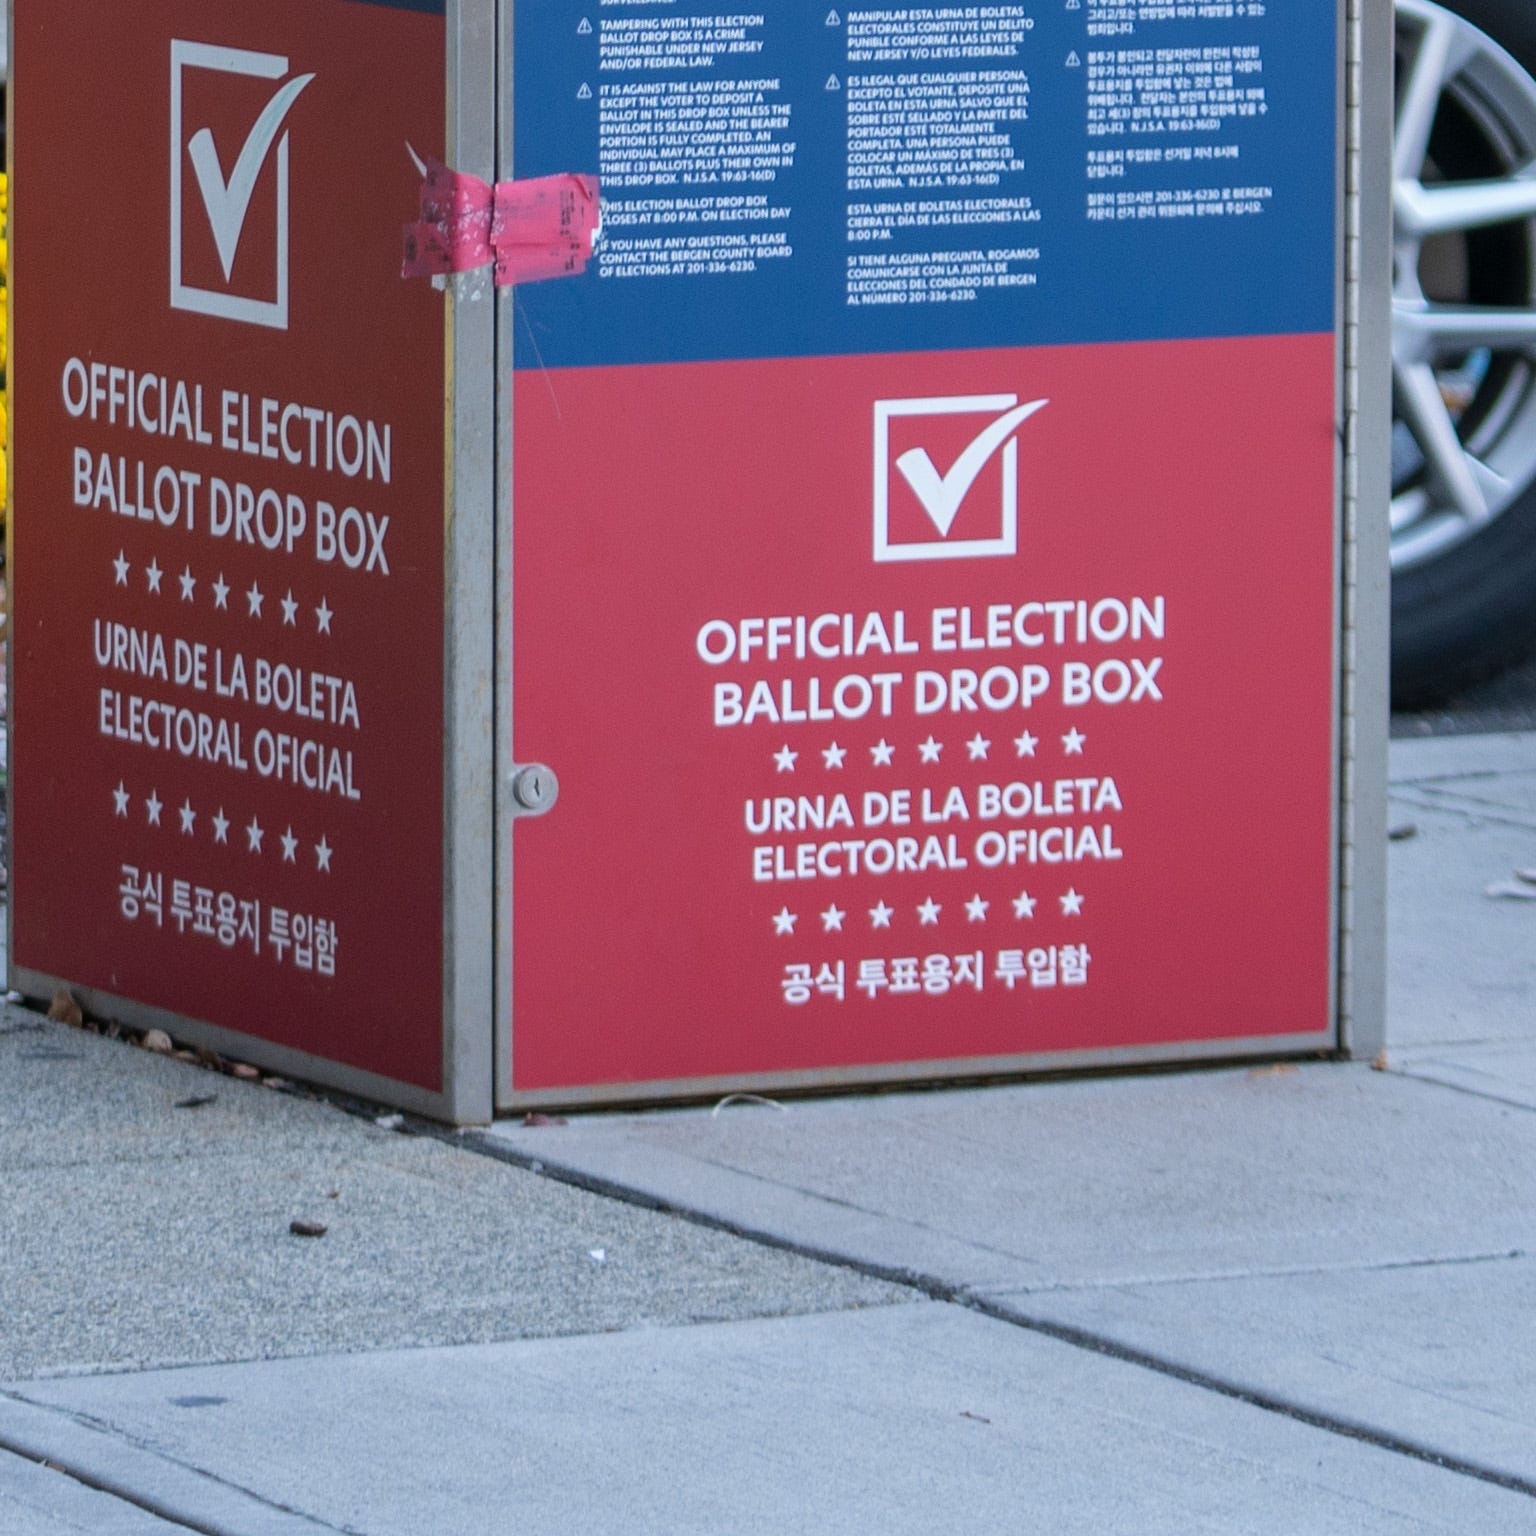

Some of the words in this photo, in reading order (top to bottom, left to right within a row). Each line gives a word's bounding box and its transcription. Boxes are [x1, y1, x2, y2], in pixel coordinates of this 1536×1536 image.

[600, 18, 660, 30] TAMPERING
[660, 17, 689, 28] WITH
[691, 16, 713, 27] THIS
[715, 15, 764, 26] ELECTION
[600, 32, 639, 43] BALLOT
[640, 31, 670, 42] DROP
[670, 30, 692, 41] BOX
[694, 30, 704, 40] IS
[705, 30, 713, 40] A
[714, 28, 745, 39] CRIME
[600, 44, 663, 56] PUNISHABLE
[665, 43, 700, 54] UNDER
[702, 42, 727, 53] NEW
[728, 41, 763, 52] JERSEY
[600, 57, 642, 69] AND/OR
[643, 56, 688, 68] FEDERAL
[599, 240, 609, 250] IF
[611, 239, 633, 250] YOU
[634, 238, 662, 249] HAVE
[664, 237, 686, 248] ANY
[750, 233, 786, 244] PLEASE
[599, 252, 647, 264] CONTACT
[649, 251, 668, 262] THE
[670, 249, 711, 261] BERGEN
[712, 247, 755, 259] COUNTY
[756, 246, 792, 257] BOARD
[599, 266, 614, 277] OF
[615, 264, 671, 276] ELECTIONS
[672, 263, 685, 273] AT
[62, 356, 212, 444] OFFICIAL
[221, 389, 391, 483] ELECTION
[73, 446, 200, 530] BALLOT
[210, 477, 306, 553] DROP
[316, 501, 390, 576] BOX
[696, 610, 918, 665] OFFICIAL
[932, 595, 1164, 650] ELECTION
[94, 618, 167, 681] URNA
[174, 638, 207, 687] DE
[215, 648, 248, 700] LA
[256, 659, 360, 730] BOLETA
[714, 673, 902, 727] BALLOT
[915, 664, 1050, 715] DROP
[1063, 657, 1163, 707] BOX
[99, 688, 247, 769] ELECTORAL
[254, 728, 360, 799] OFICIAL
[745, 793, 854, 834] URNA
[864, 790, 910, 827] DE
[922, 785, 968, 823] LA
[978, 777, 1123, 819] BOLETA
[753, 834, 967, 882] ELECTORAL
[975, 825, 1123, 866] OFICIAL
[119, 864, 163, 928] 공식
[170, 877, 260, 955] 투표용지
[269, 906, 339, 976] 투입함
[782, 961, 846, 1005] 공식
[857, 951, 984, 999] 투표용지
[995, 944, 1092, 988] 투입함
